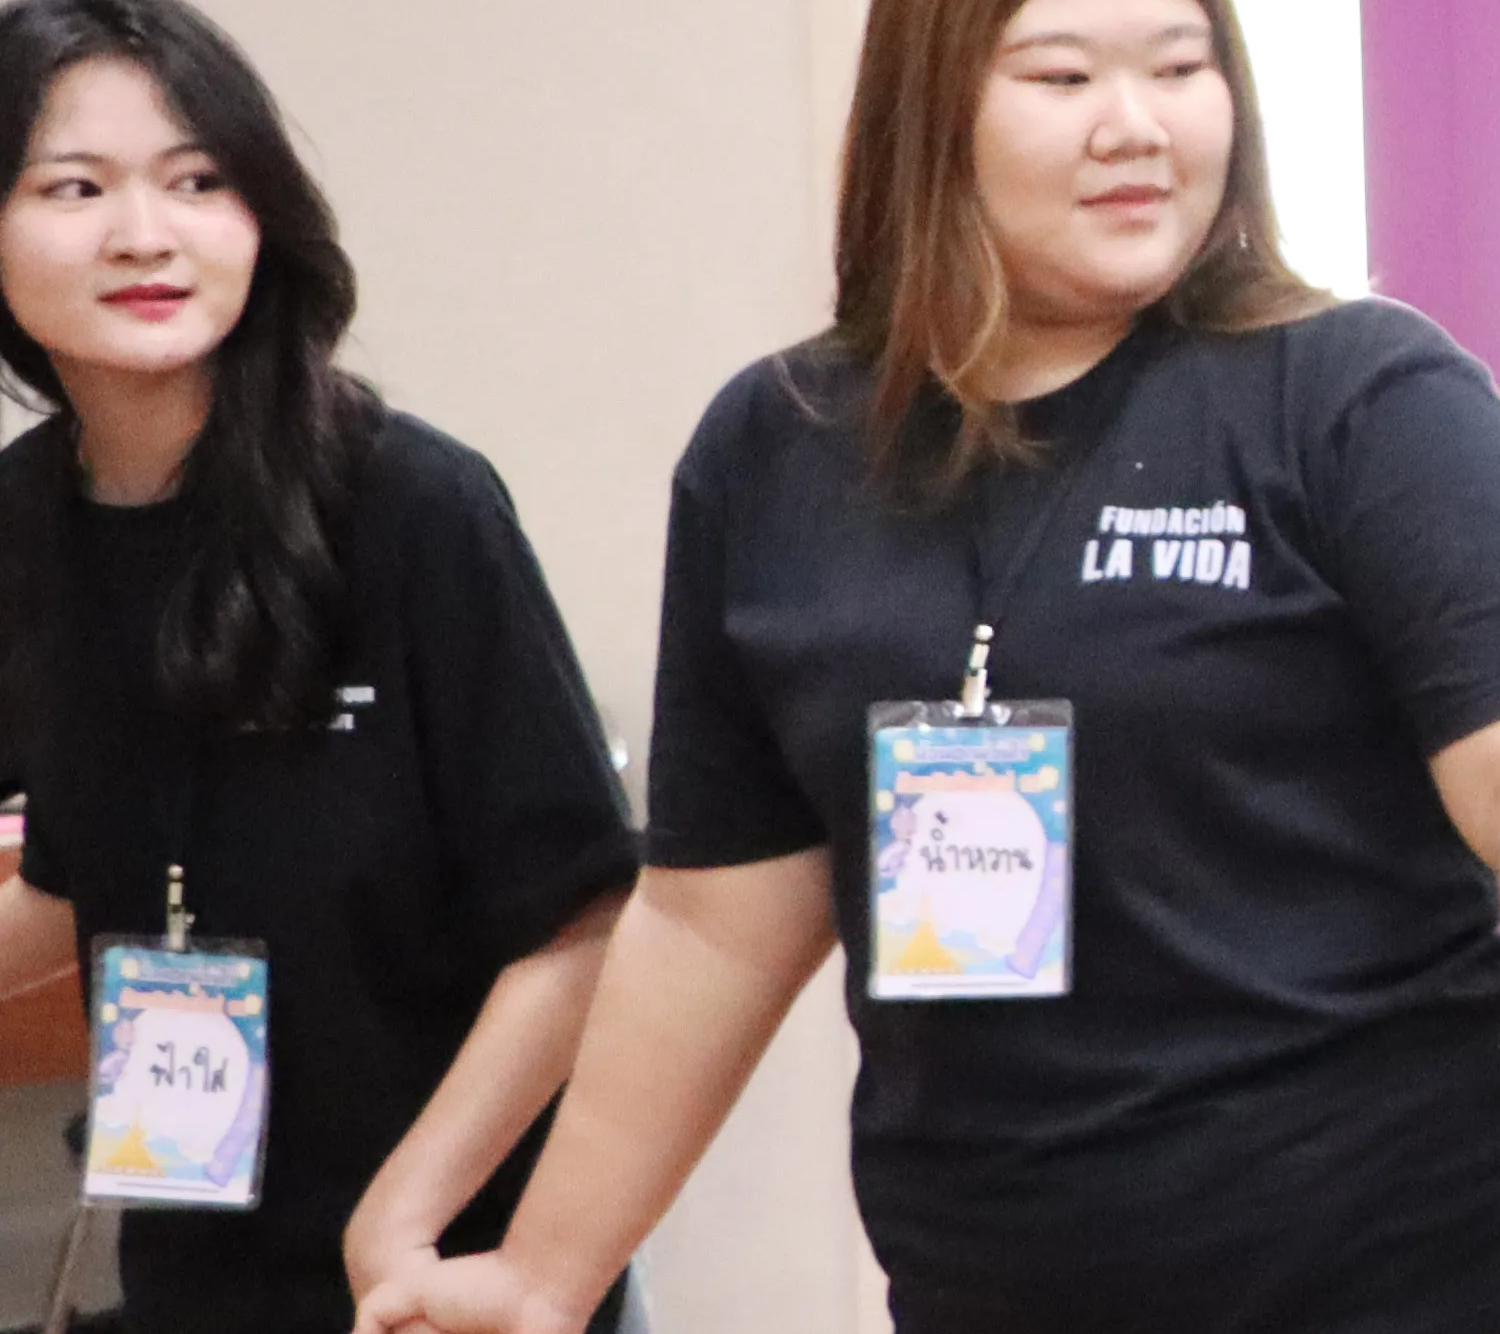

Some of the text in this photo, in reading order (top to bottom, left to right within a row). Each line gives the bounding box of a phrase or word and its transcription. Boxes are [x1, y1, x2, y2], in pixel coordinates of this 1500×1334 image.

[1099, 500, 1246, 536] FUNDACIÓN
[1081, 539, 1252, 590] LA VIDA
[919, 809, 1034, 874] น้ำหวาน
